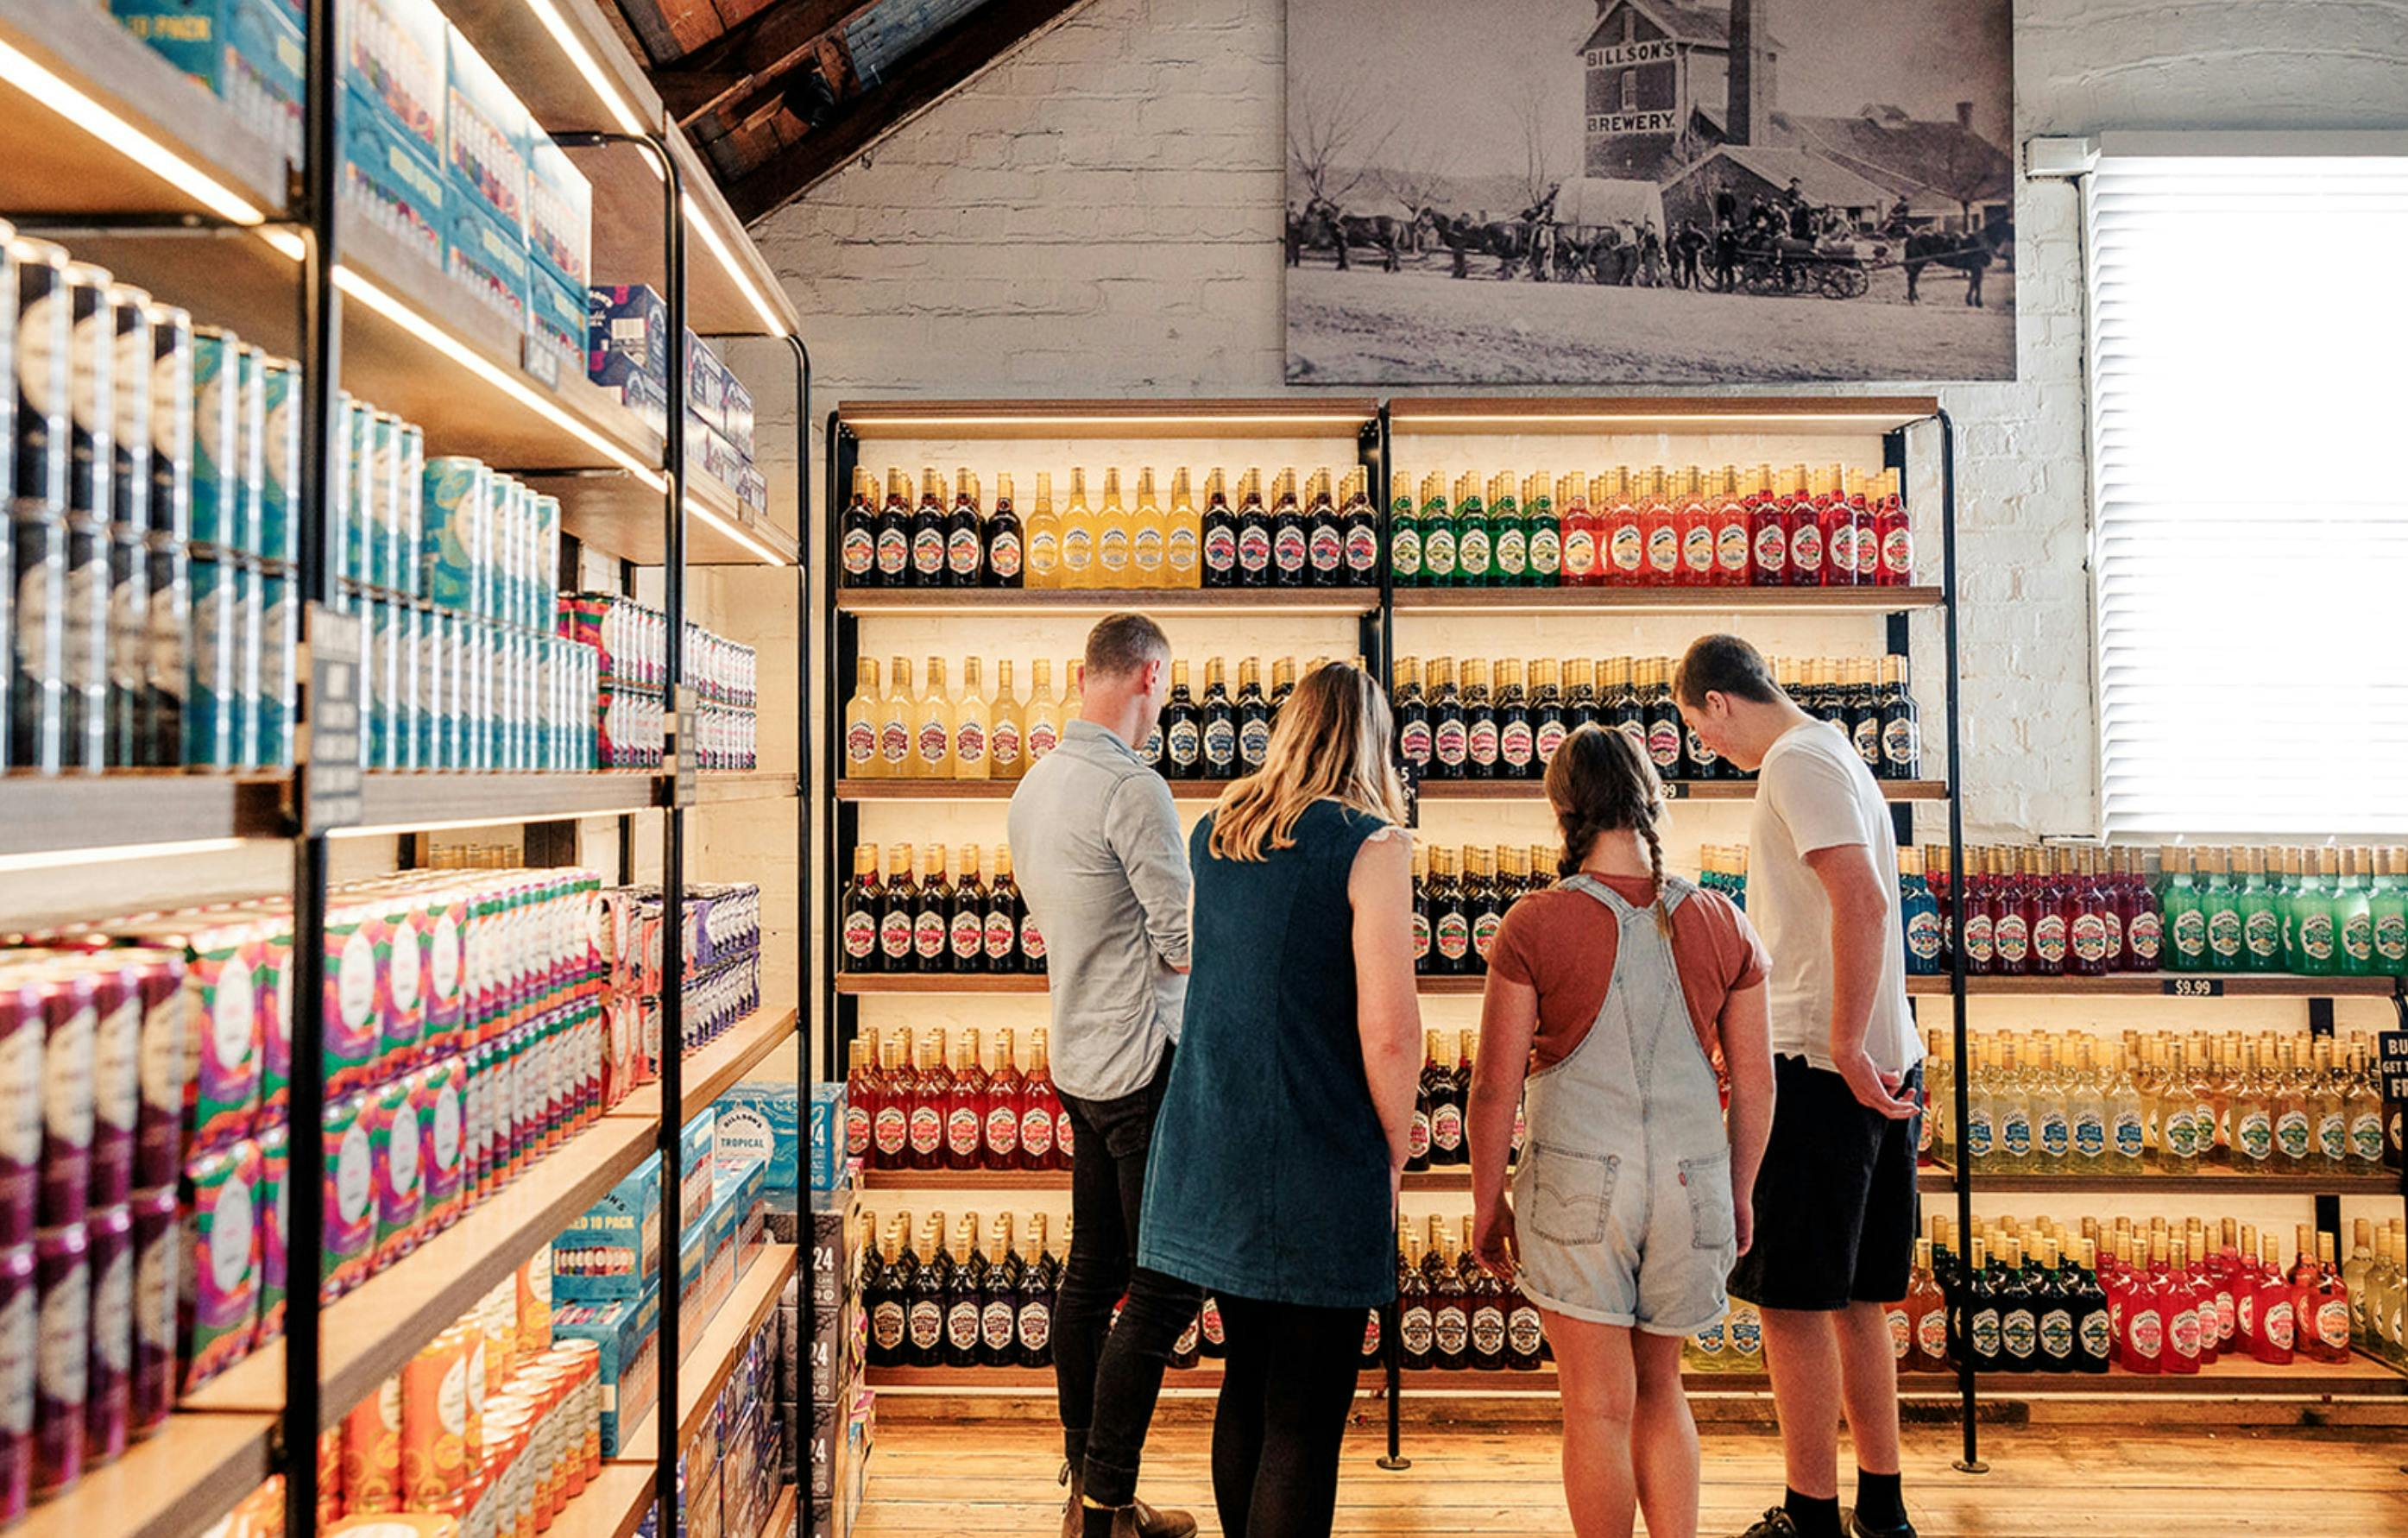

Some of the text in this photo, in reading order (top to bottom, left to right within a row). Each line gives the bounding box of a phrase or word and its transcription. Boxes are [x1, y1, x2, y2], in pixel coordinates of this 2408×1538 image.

[1586, 42, 1675, 66] BILLSON'S
[2175, 979, 2211, 996] $9.99
[2382, 1061, 2402, 1073] GET
[721, 1138, 764, 1148] TROPICAL
[605, 1215, 634, 1229] PACK
[813, 1246, 835, 1271] 24
